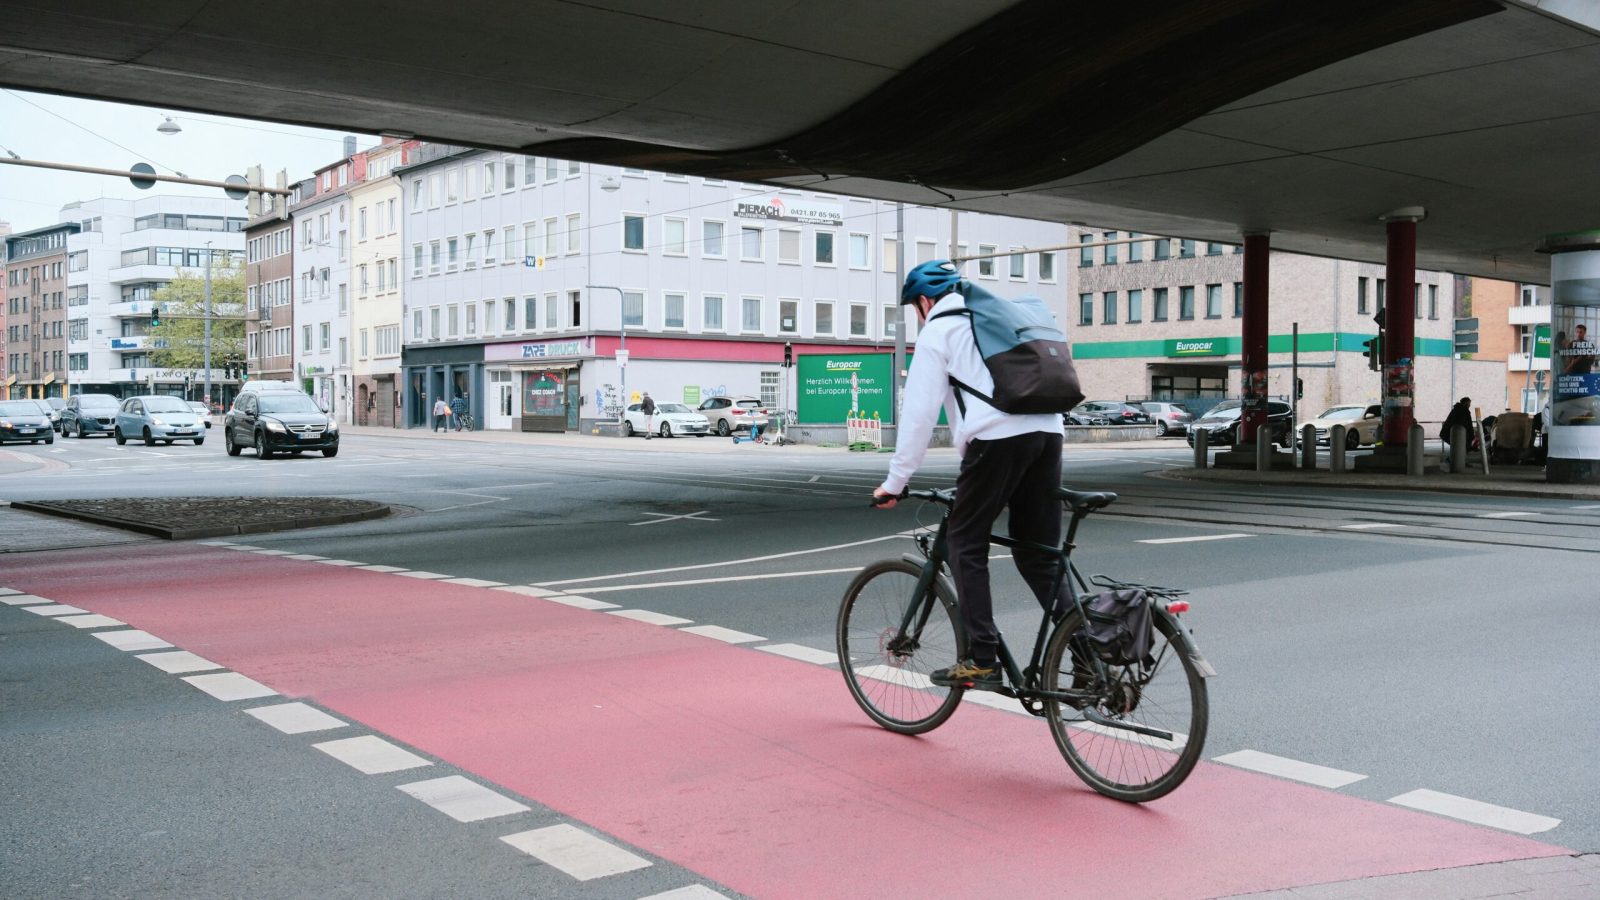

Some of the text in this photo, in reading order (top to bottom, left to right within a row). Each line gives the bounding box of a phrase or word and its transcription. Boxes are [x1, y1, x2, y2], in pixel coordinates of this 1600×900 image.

[738, 203, 779, 216] PIERACH
[548, 342, 580, 356] DRUCK
[1176, 342, 1213, 352] Europcar
[826, 360, 862, 369] Europcar
[818, 387, 847, 395] Europcar
